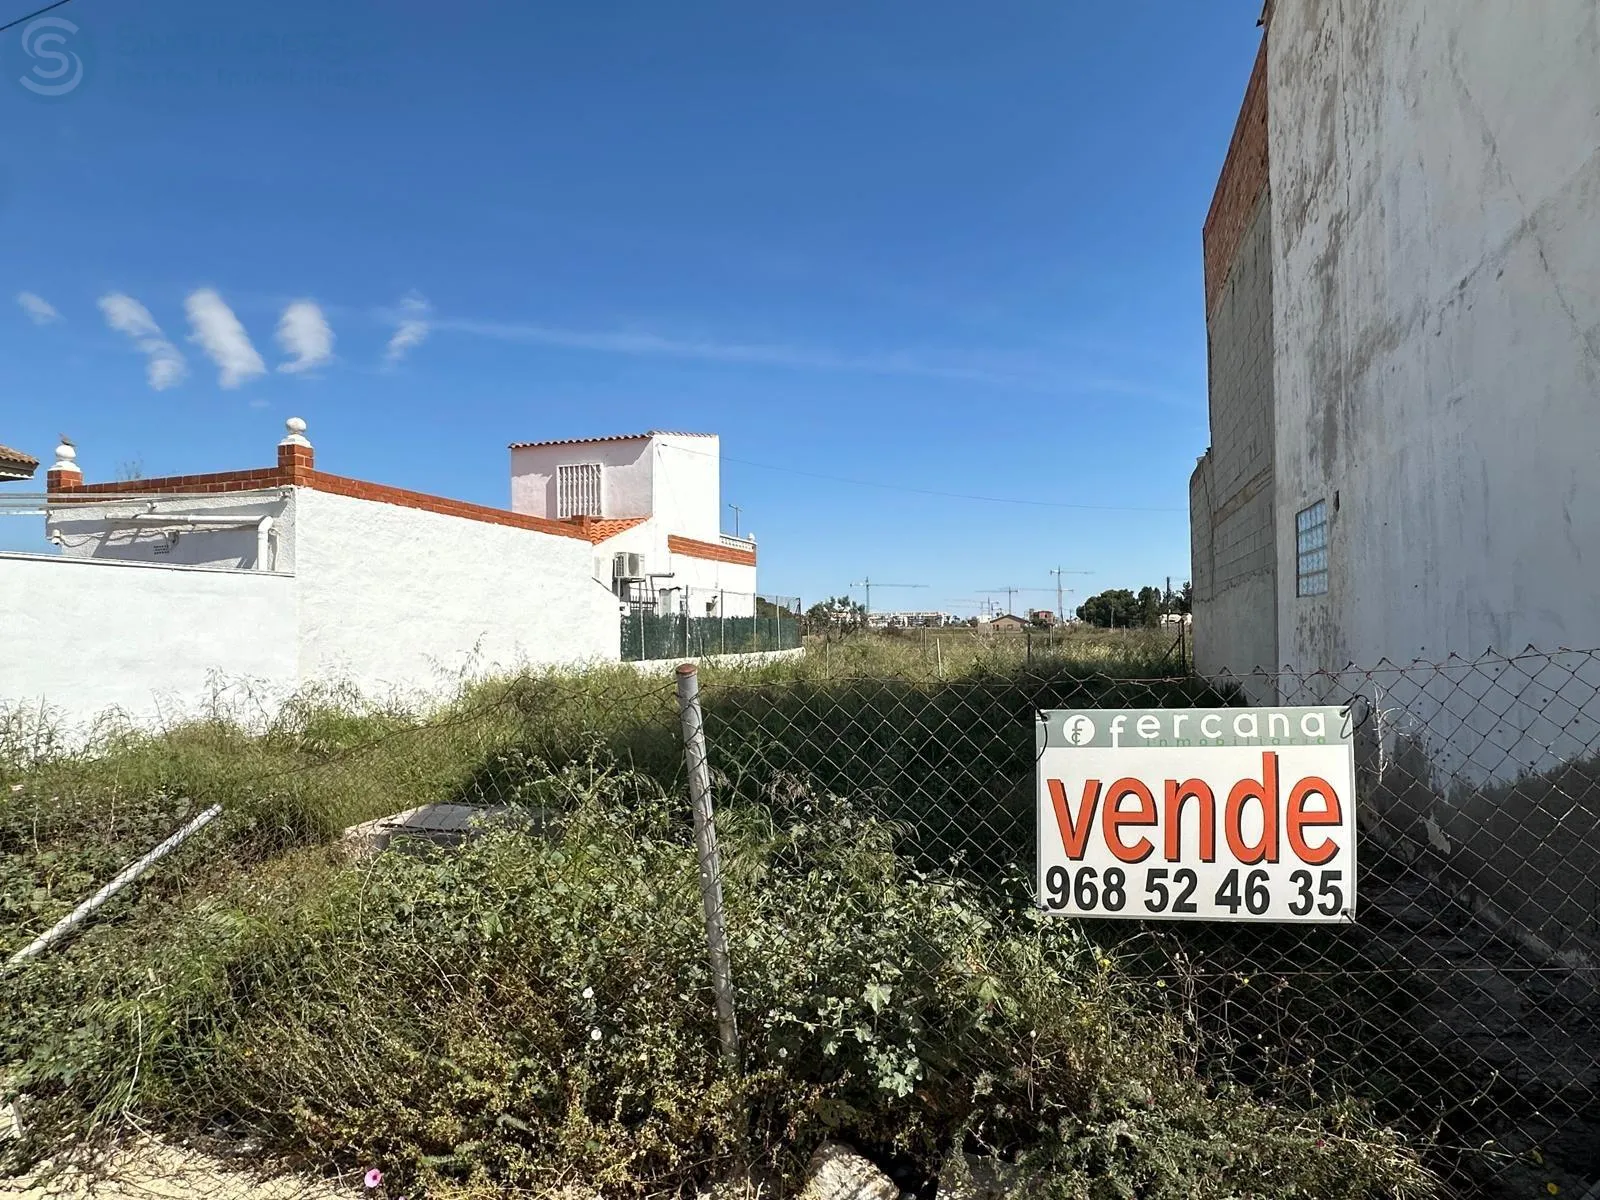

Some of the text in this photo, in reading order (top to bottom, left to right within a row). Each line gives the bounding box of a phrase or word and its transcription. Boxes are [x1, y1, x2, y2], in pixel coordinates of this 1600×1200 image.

[1109, 712, 1326, 748] fercana
[1046, 751, 1342, 864] vende
[1046, 865, 1343, 917] 968 52 46 35
